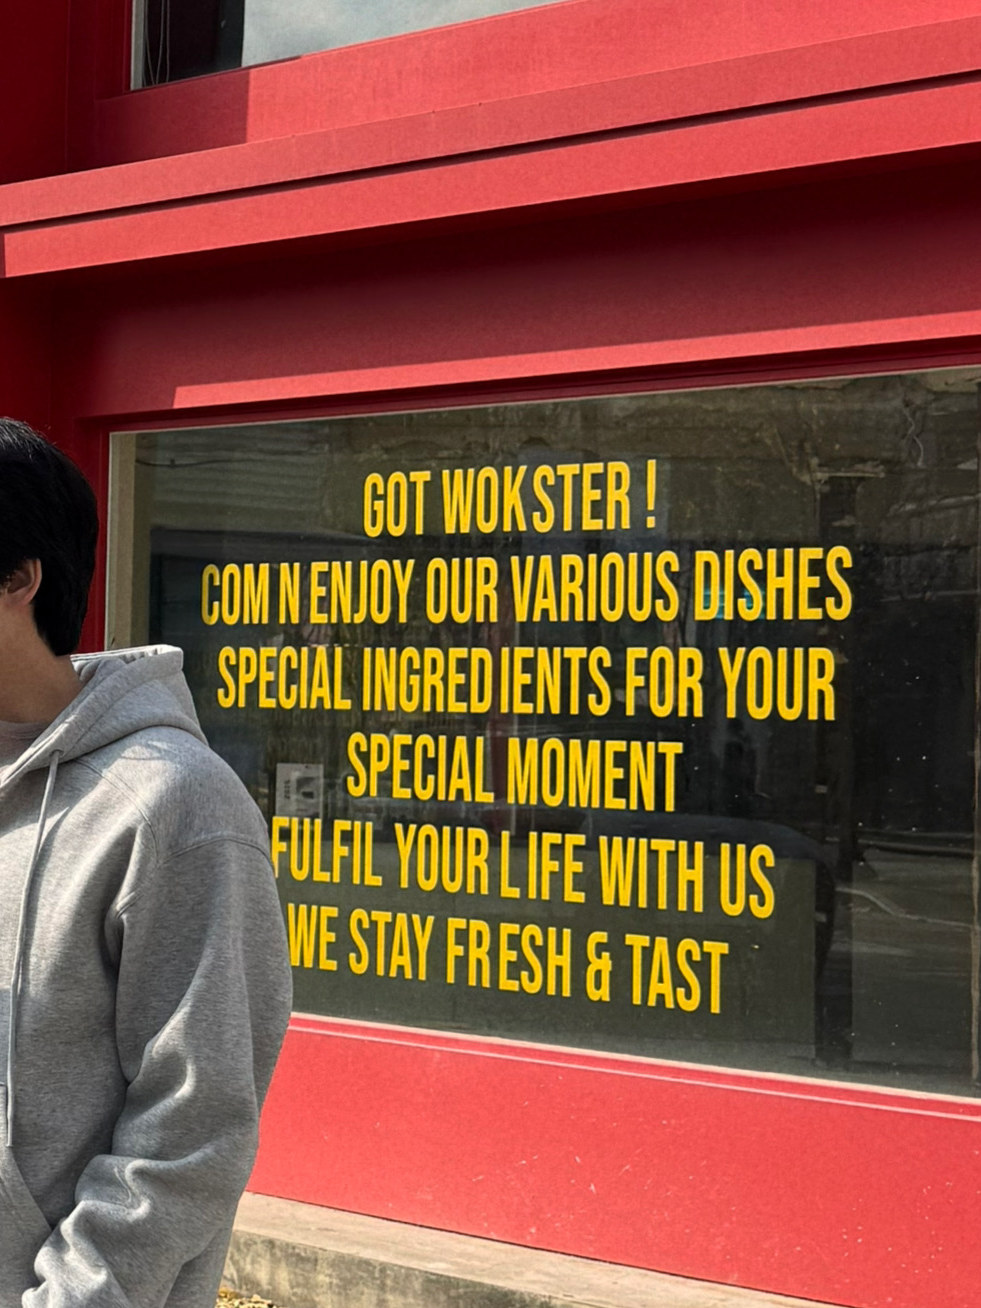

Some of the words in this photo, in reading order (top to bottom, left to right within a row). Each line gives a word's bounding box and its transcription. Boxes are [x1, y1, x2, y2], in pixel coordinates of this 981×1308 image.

[363, 470, 430, 538] GOT
[441, 462, 630, 535] WOKSTER
[646, 460, 656, 529] !
[201, 563, 269, 626] COM
[279, 562, 300, 625] N
[310, 560, 415, 625] ENJOY
[426, 558, 498, 624] OUR
[510, 550, 680, 623] VARIOUS
[694, 546, 853, 622] DISHES
[217, 646, 352, 710] SPECIAL
[363, 647, 611, 716] INGREDIENTS
[626, 646, 703, 717] FOR
[718, 647, 836, 721] YOUR
[346, 732, 494, 803] SPECIAL
[506, 737, 684, 812] MOMENT
[271, 816, 383, 887] FULFIL
[394, 823, 490, 896] YOUR
[501, 830, 586, 904] LIFE
[598, 836, 705, 913] WITH
[719, 843, 776, 919] US
[287, 903, 339, 971] WE
[348, 908, 435, 981] STAY
[446, 917, 572, 998] FRESH
[586, 931, 612, 1003] &
[624, 934, 730, 1014] TAST
